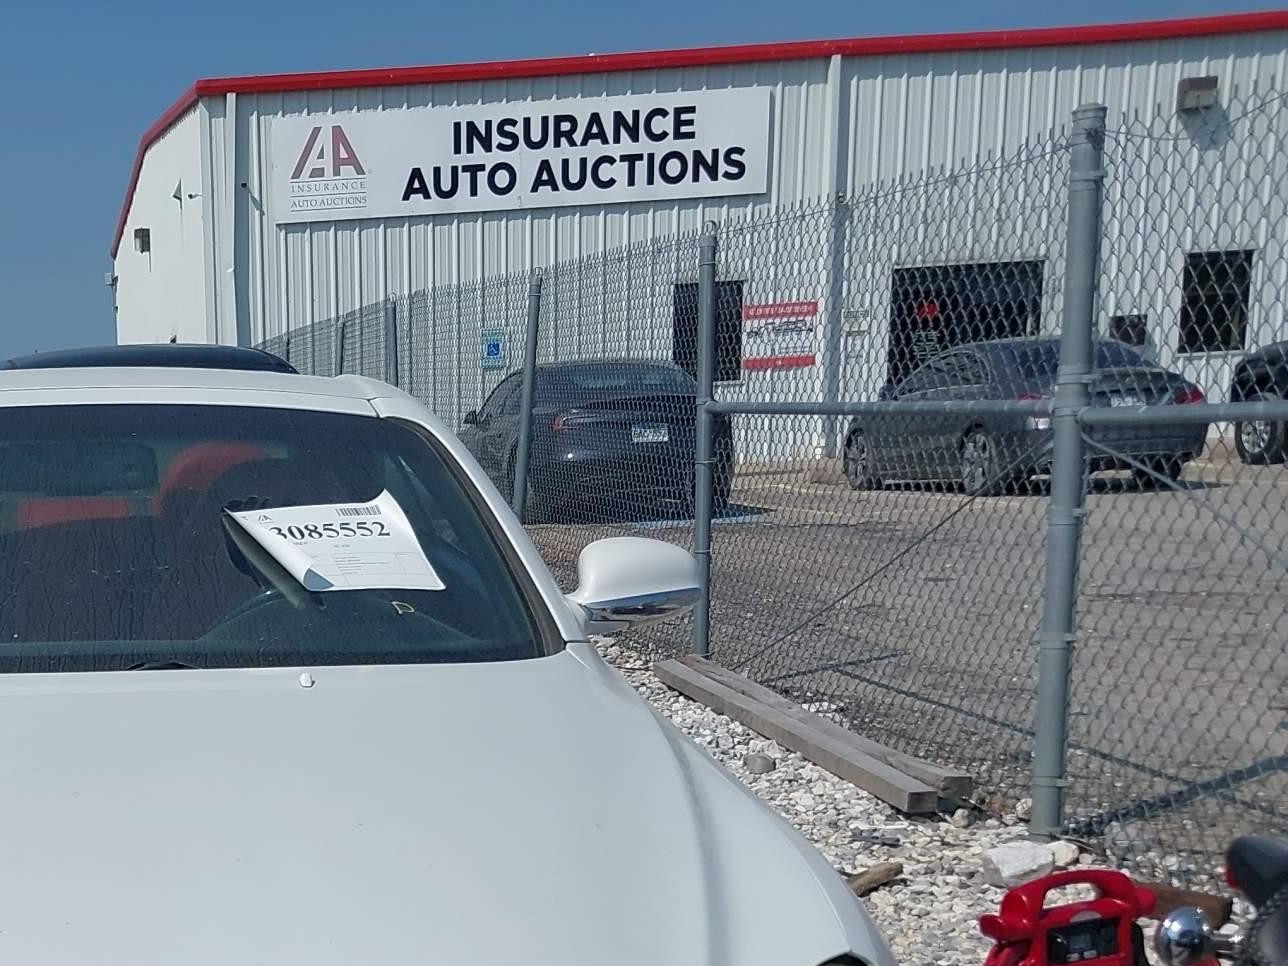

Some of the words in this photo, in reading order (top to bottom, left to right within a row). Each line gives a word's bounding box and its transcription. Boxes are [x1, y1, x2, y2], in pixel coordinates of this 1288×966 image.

[454, 105, 697, 155] INSURANCE
[291, 180, 367, 193] INSURANCE
[401, 161, 517, 202] AUTO
[530, 146, 746, 193] AUCTIONS
[290, 198, 318, 209] AUTO
[319, 195, 368, 208] AUCTIONS
